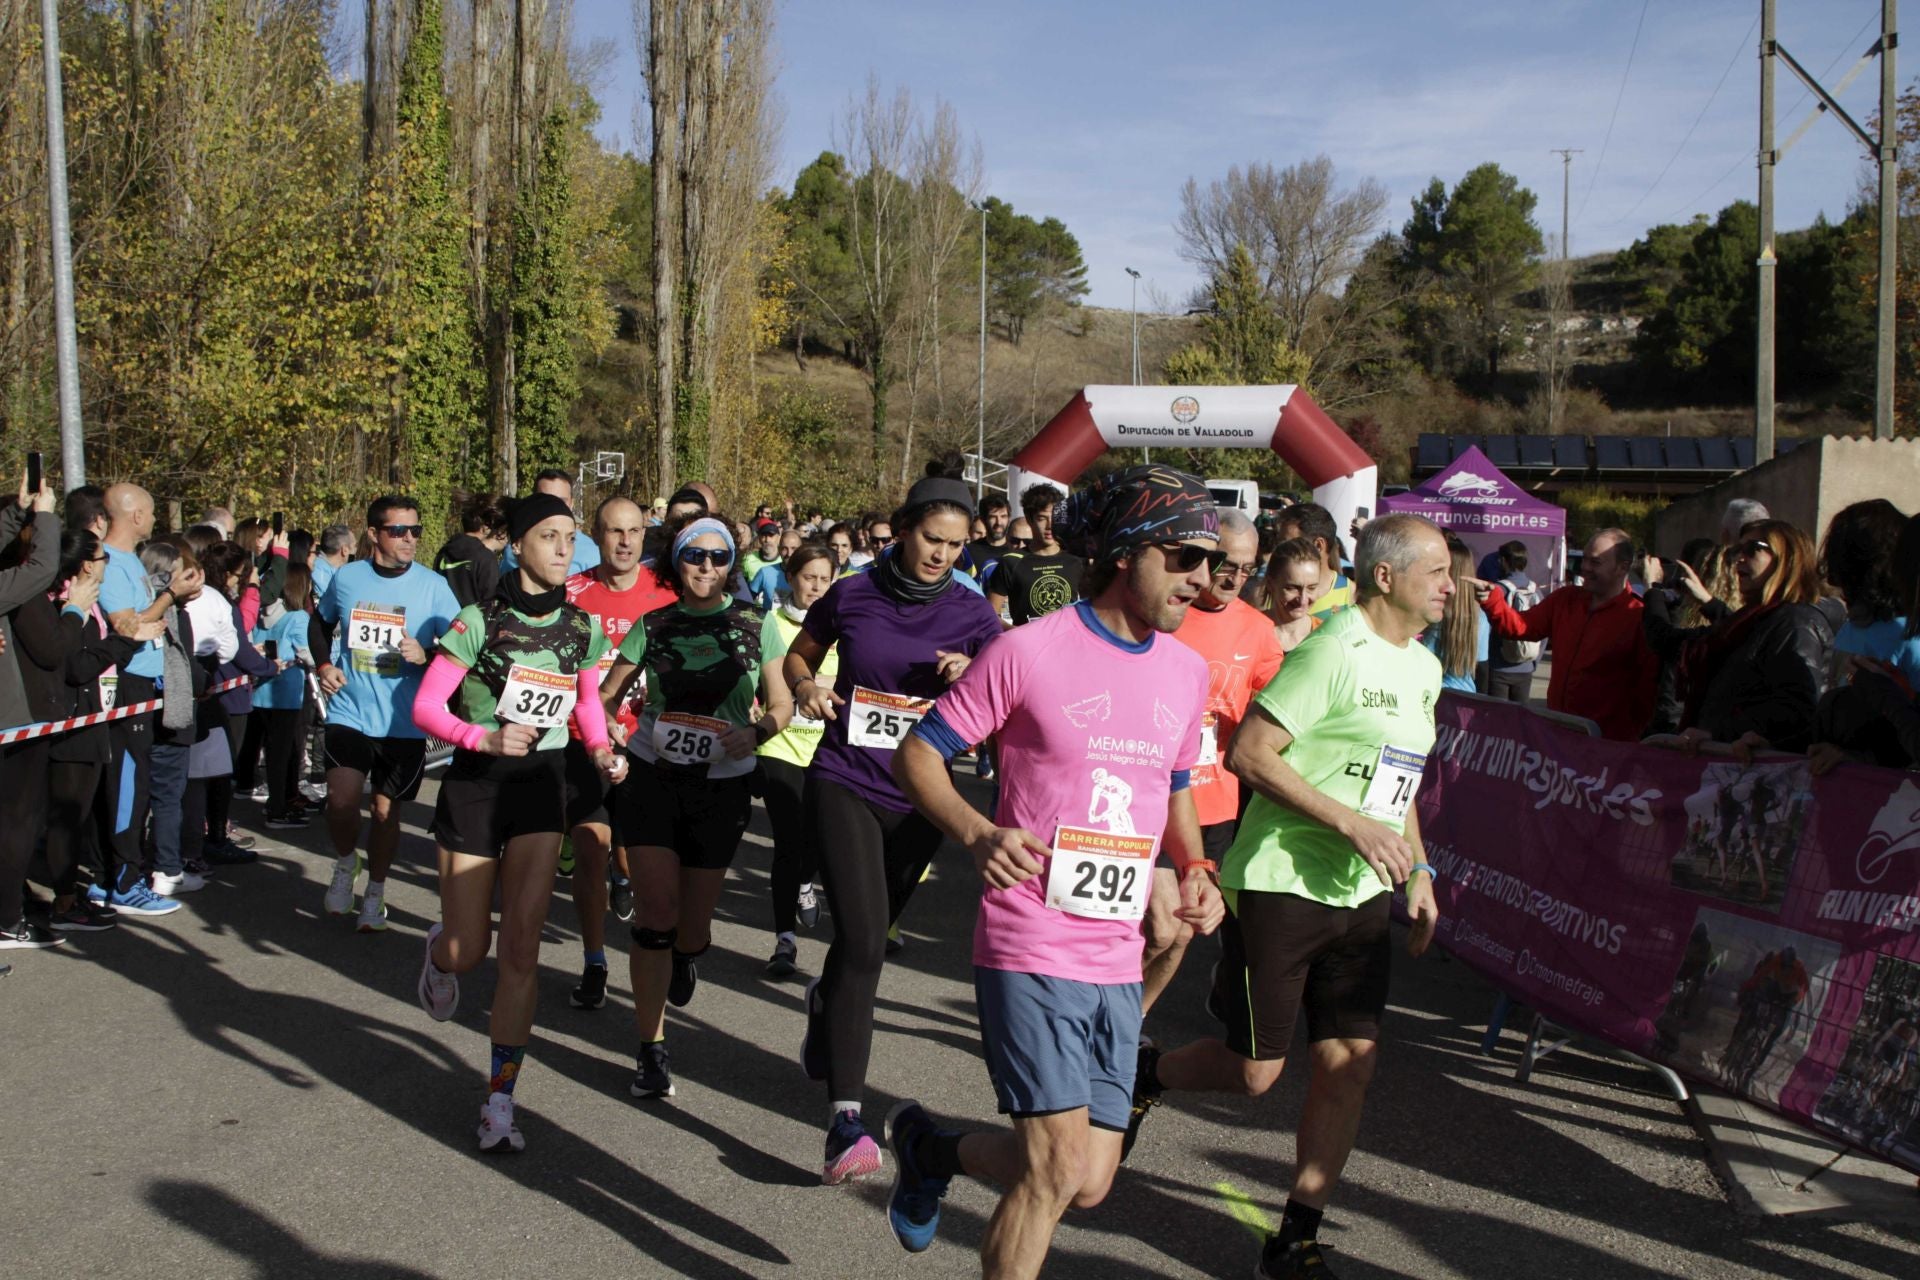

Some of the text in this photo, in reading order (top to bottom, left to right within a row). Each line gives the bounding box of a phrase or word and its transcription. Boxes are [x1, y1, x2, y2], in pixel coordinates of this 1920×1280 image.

[1177, 428, 1190, 436] DE
[359, 624, 392, 646] 311
[516, 689, 564, 717] 320
[865, 710, 918, 738] 257
[664, 728, 713, 759] 258
[1087, 735, 1166, 759] MEMORIAL
[1109, 753, 1136, 766] Negro
[1136, 756, 1149, 765] de
[1391, 775, 1414, 808] 74
[1061, 832, 1153, 850] CARRERA POPULAR
[1071, 860, 1136, 903] 292
